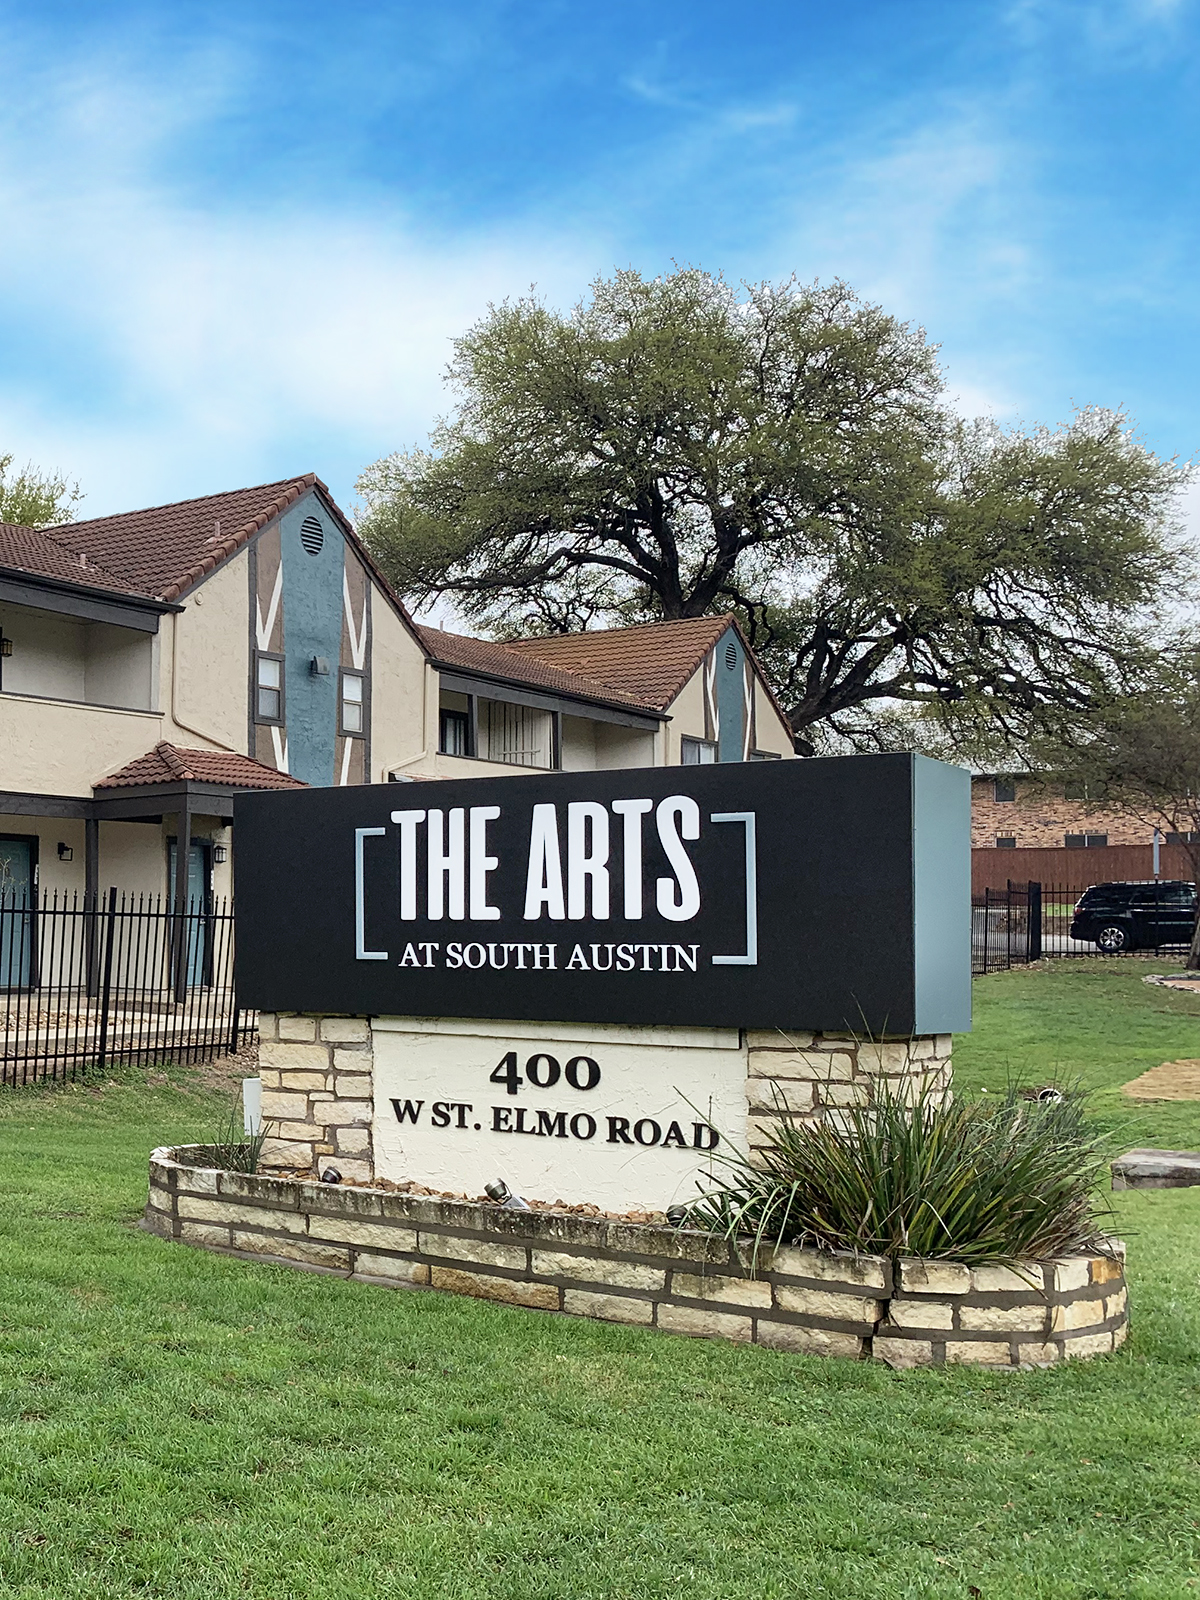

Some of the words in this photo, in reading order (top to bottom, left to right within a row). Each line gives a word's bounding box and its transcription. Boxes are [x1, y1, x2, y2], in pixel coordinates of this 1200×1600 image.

[391, 805, 500, 920] THE
[523, 795, 700, 921] ARTS
[398, 942, 439, 968] AT
[446, 942, 557, 970] SOUTH
[565, 943, 701, 972] AUSTIN
[489, 1051, 601, 1095] 400
[389, 1098, 425, 1125] W
[431, 1101, 481, 1131] ST.
[490, 1106, 597, 1140] ELMO
[606, 1116, 720, 1150] ROAD
